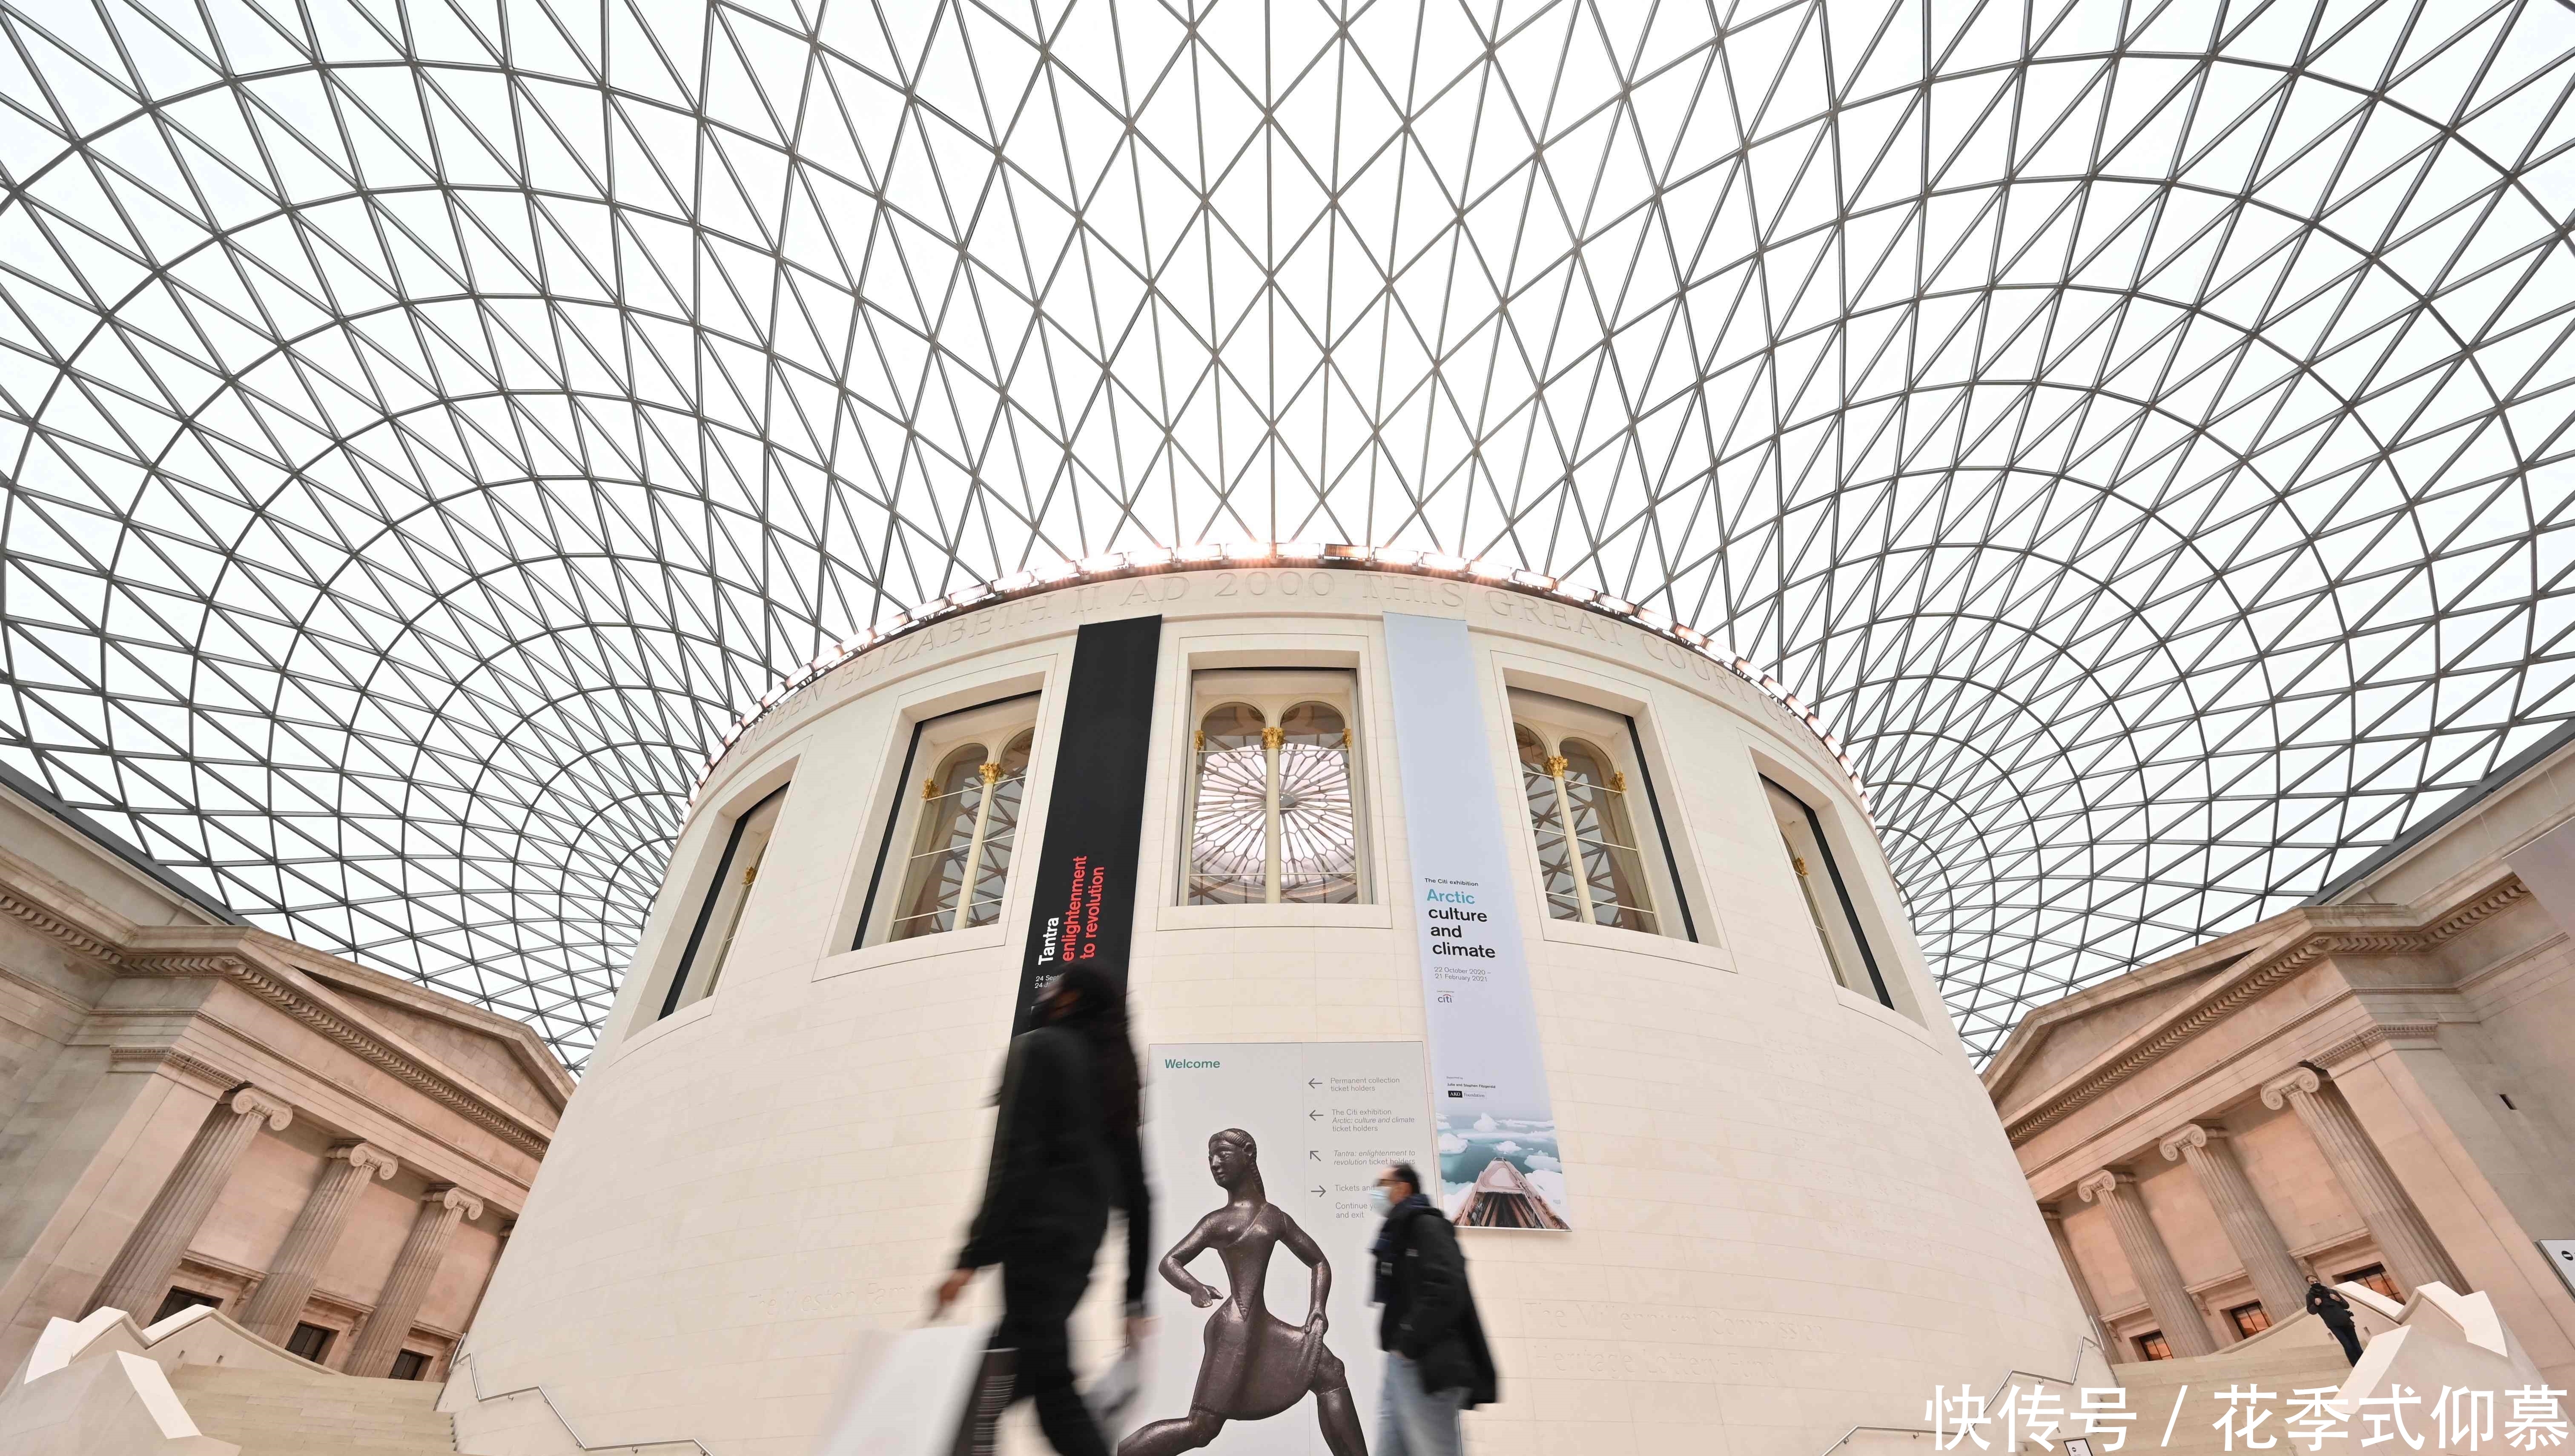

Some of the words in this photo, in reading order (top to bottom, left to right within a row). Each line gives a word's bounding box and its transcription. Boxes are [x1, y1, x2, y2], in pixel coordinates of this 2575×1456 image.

[1070, 585, 1104, 614] II
[1119, 573, 1190, 606] AD
[1215, 570, 1336, 598] 2000
[1354, 573, 1466, 608] THIS
[1485, 589, 1626, 647] GREAT
[1639, 632, 1752, 703] COURT
[1085, 867, 1105, 938] revolution
[1427, 889, 1475, 904] Arctic
[1061, 856, 1087, 962] enlightenment
[1428, 907, 1488, 922] culture
[1431, 925, 1462, 937] and
[1038, 917, 1059, 965] Tantra
[1432, 941, 1496, 958] climate
[1080, 943, 1095, 960] to
[1438, 994, 1452, 1003] citi
[1165, 1059, 1220, 1069] Welcome
